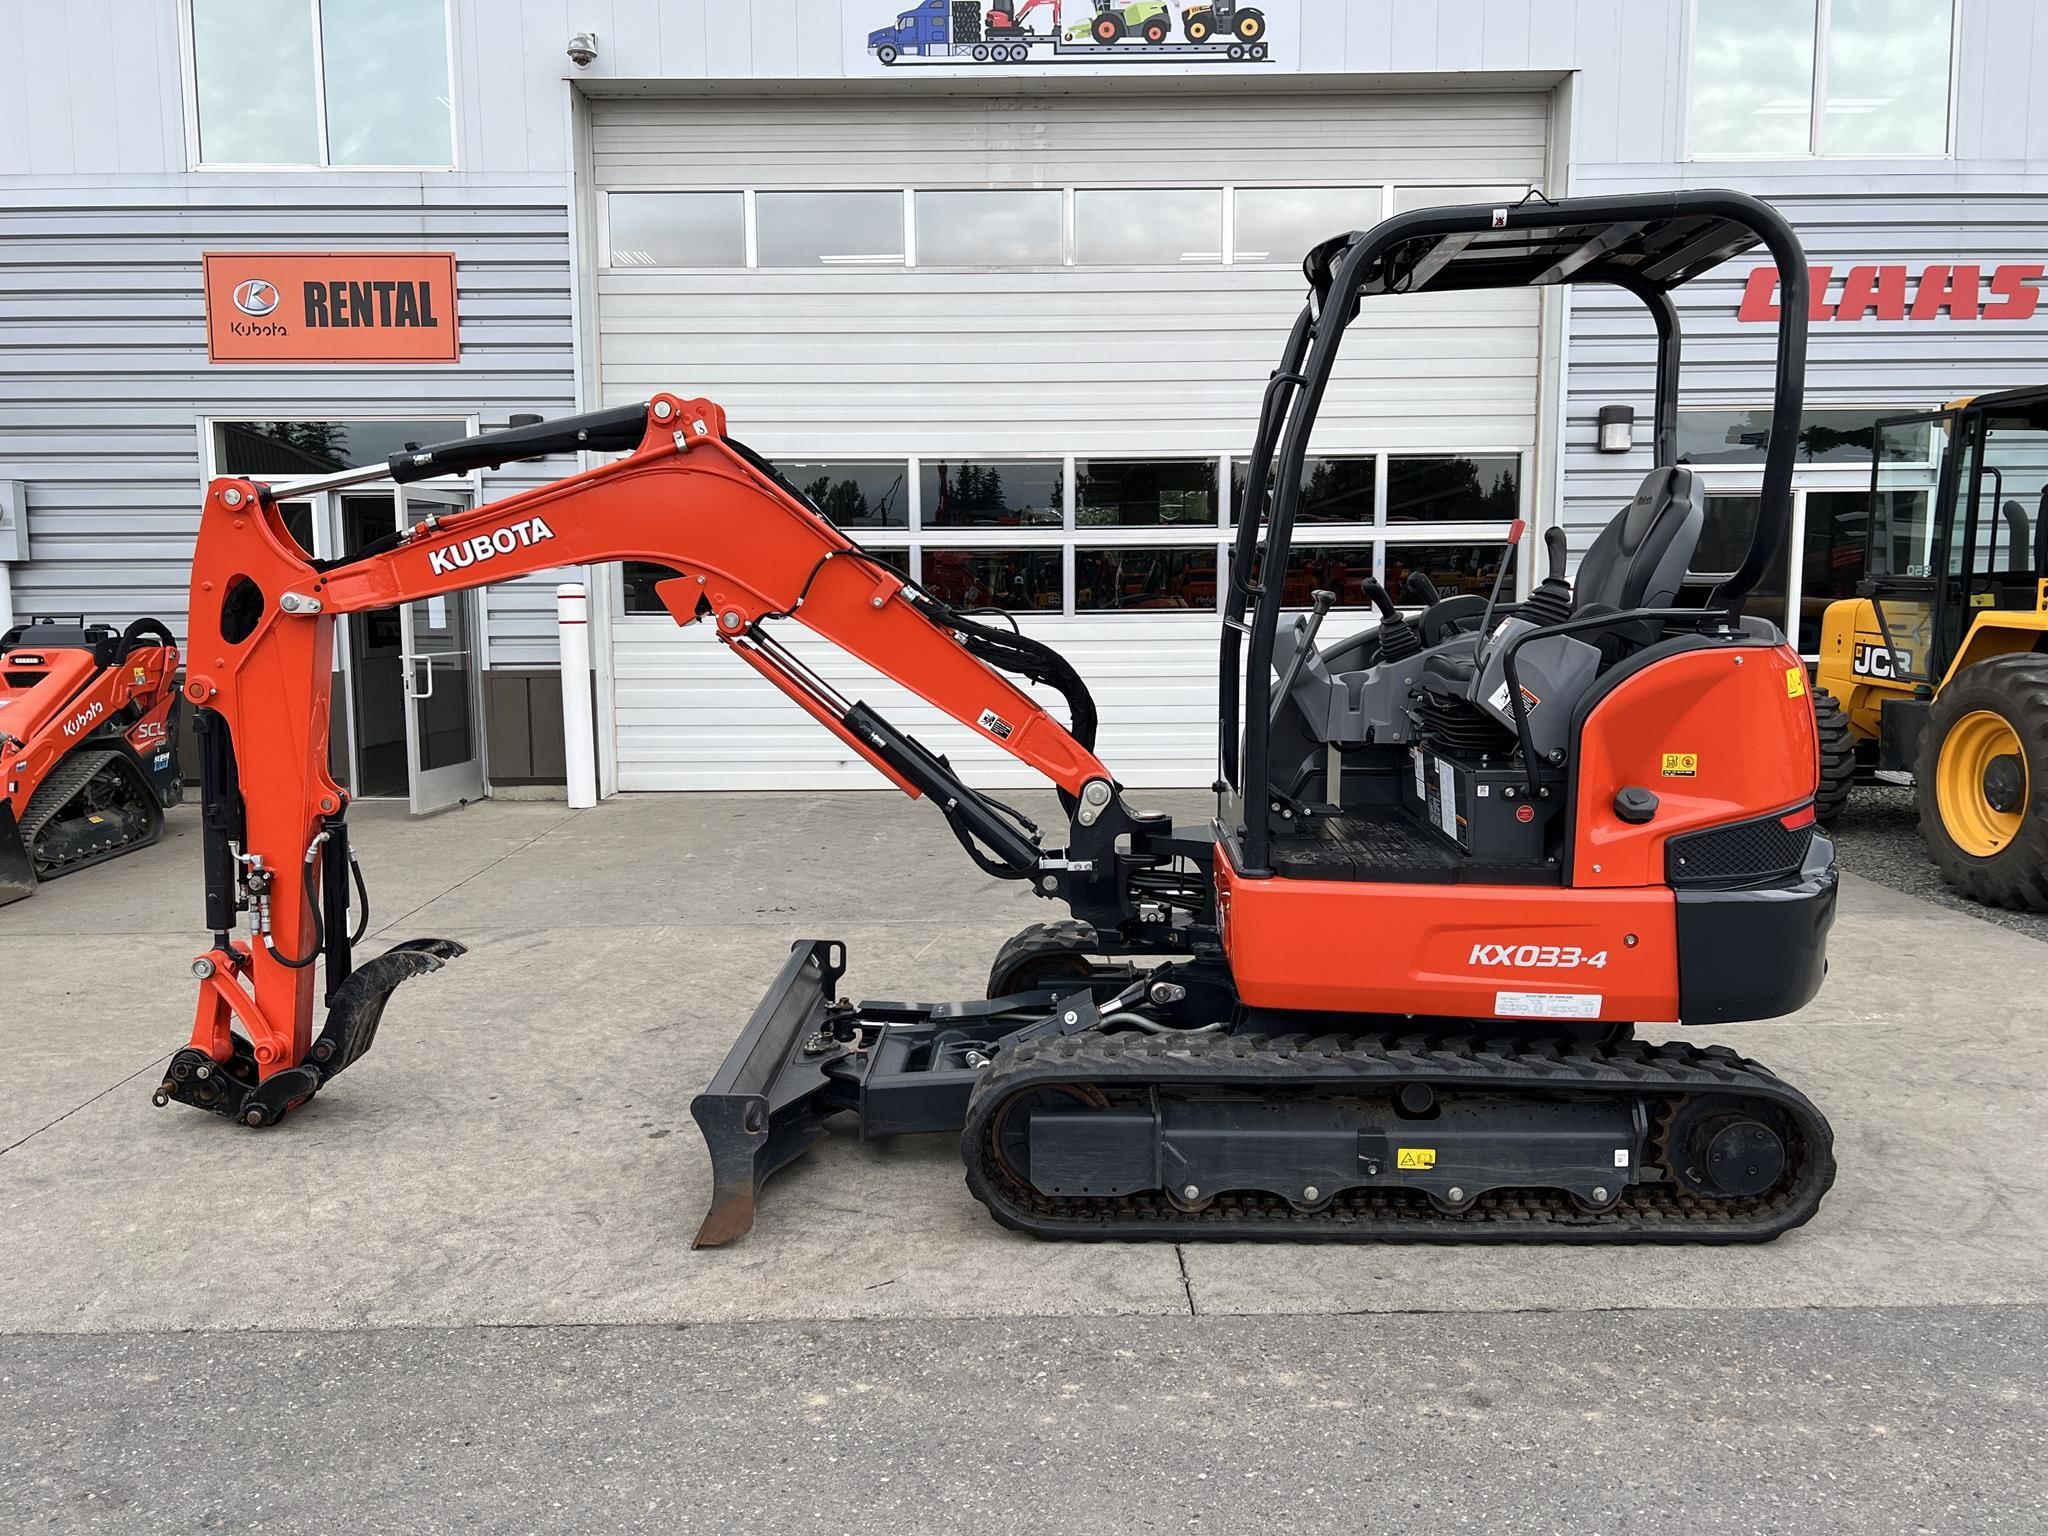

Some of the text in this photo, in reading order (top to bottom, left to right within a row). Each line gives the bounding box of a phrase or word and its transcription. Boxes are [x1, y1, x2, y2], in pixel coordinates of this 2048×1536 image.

[304, 281, 438, 328] RENTAL
[1738, 265, 2045, 322] CLAAS
[231, 322, 287, 336] Kubota
[428, 516, 555, 576] KUBOTA
[1854, 647, 1911, 678] JCB
[63, 702, 104, 737] Kubota
[138, 722, 166, 739] SCL
[1468, 944, 1608, 968] KX033-4
